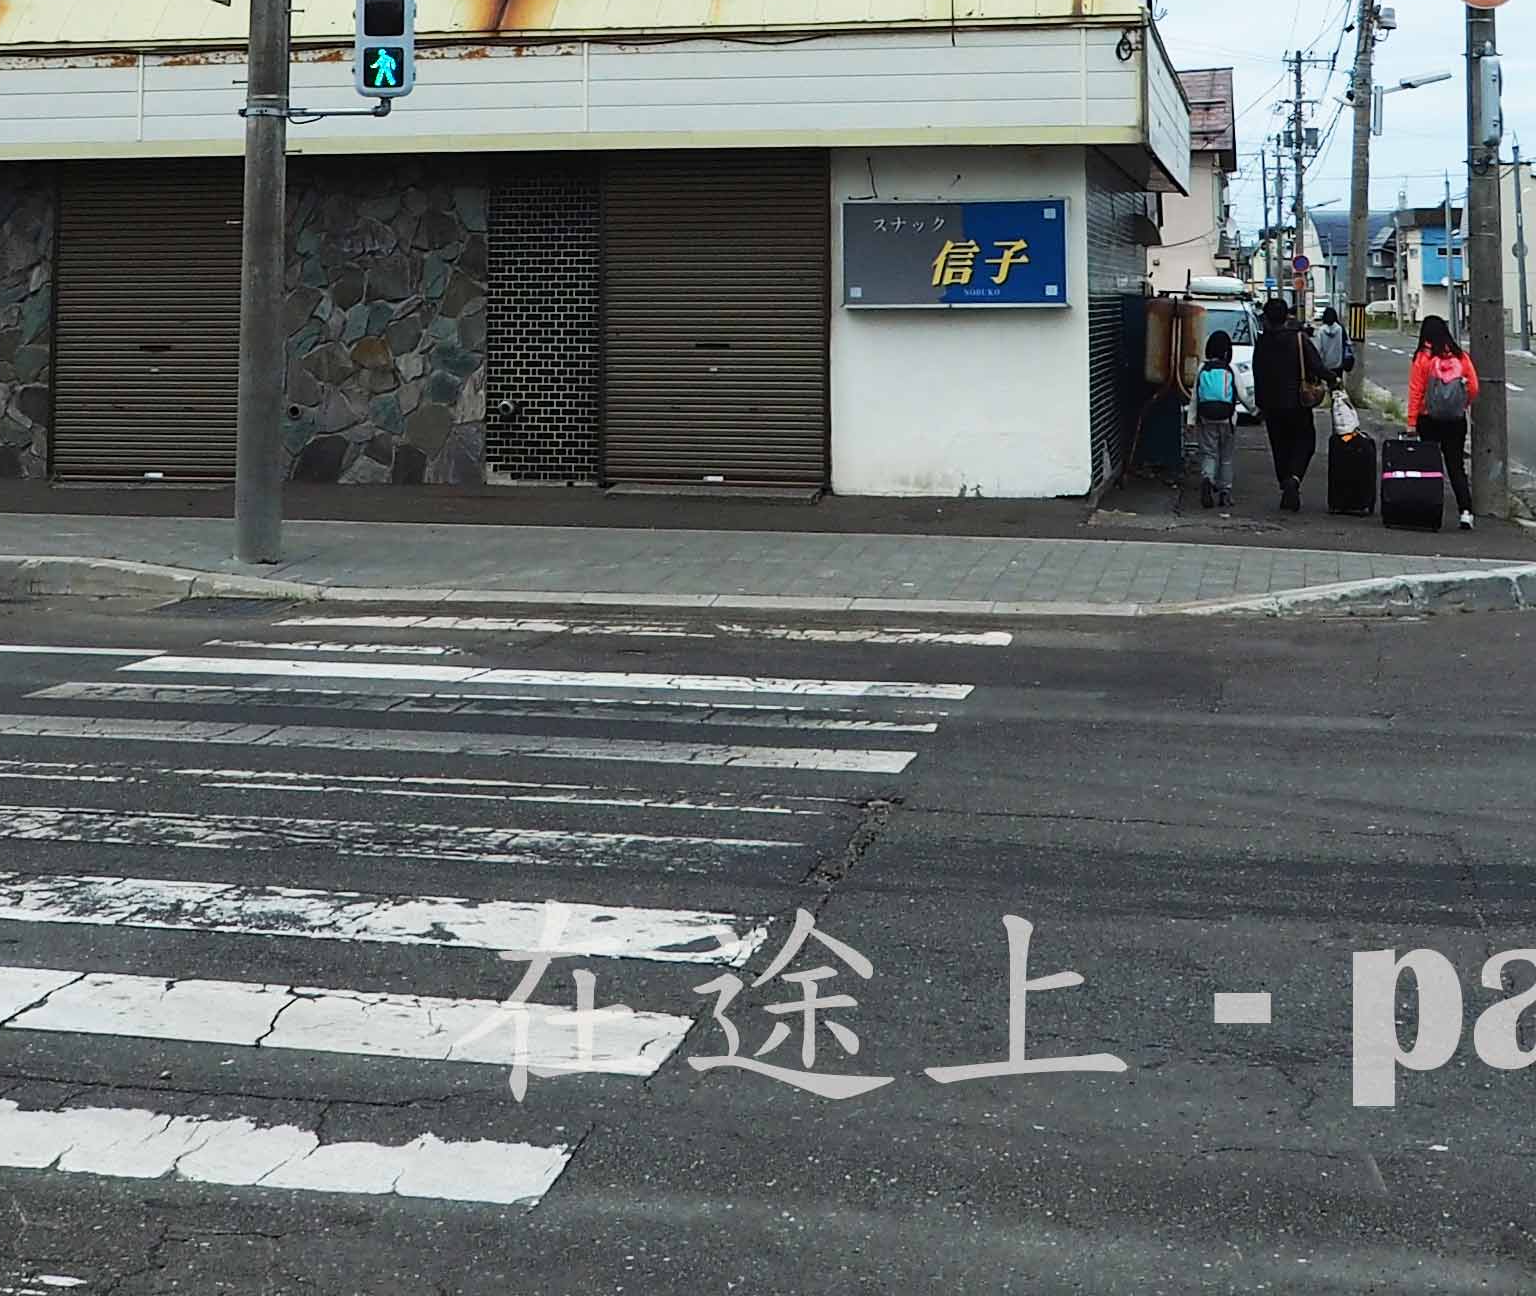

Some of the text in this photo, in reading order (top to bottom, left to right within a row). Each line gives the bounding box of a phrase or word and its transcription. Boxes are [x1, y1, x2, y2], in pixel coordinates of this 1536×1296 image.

[872, 215, 946, 233] スナック
[931, 239, 1030, 287] 信子
[963, 288, 1001, 297] NOBUKO
